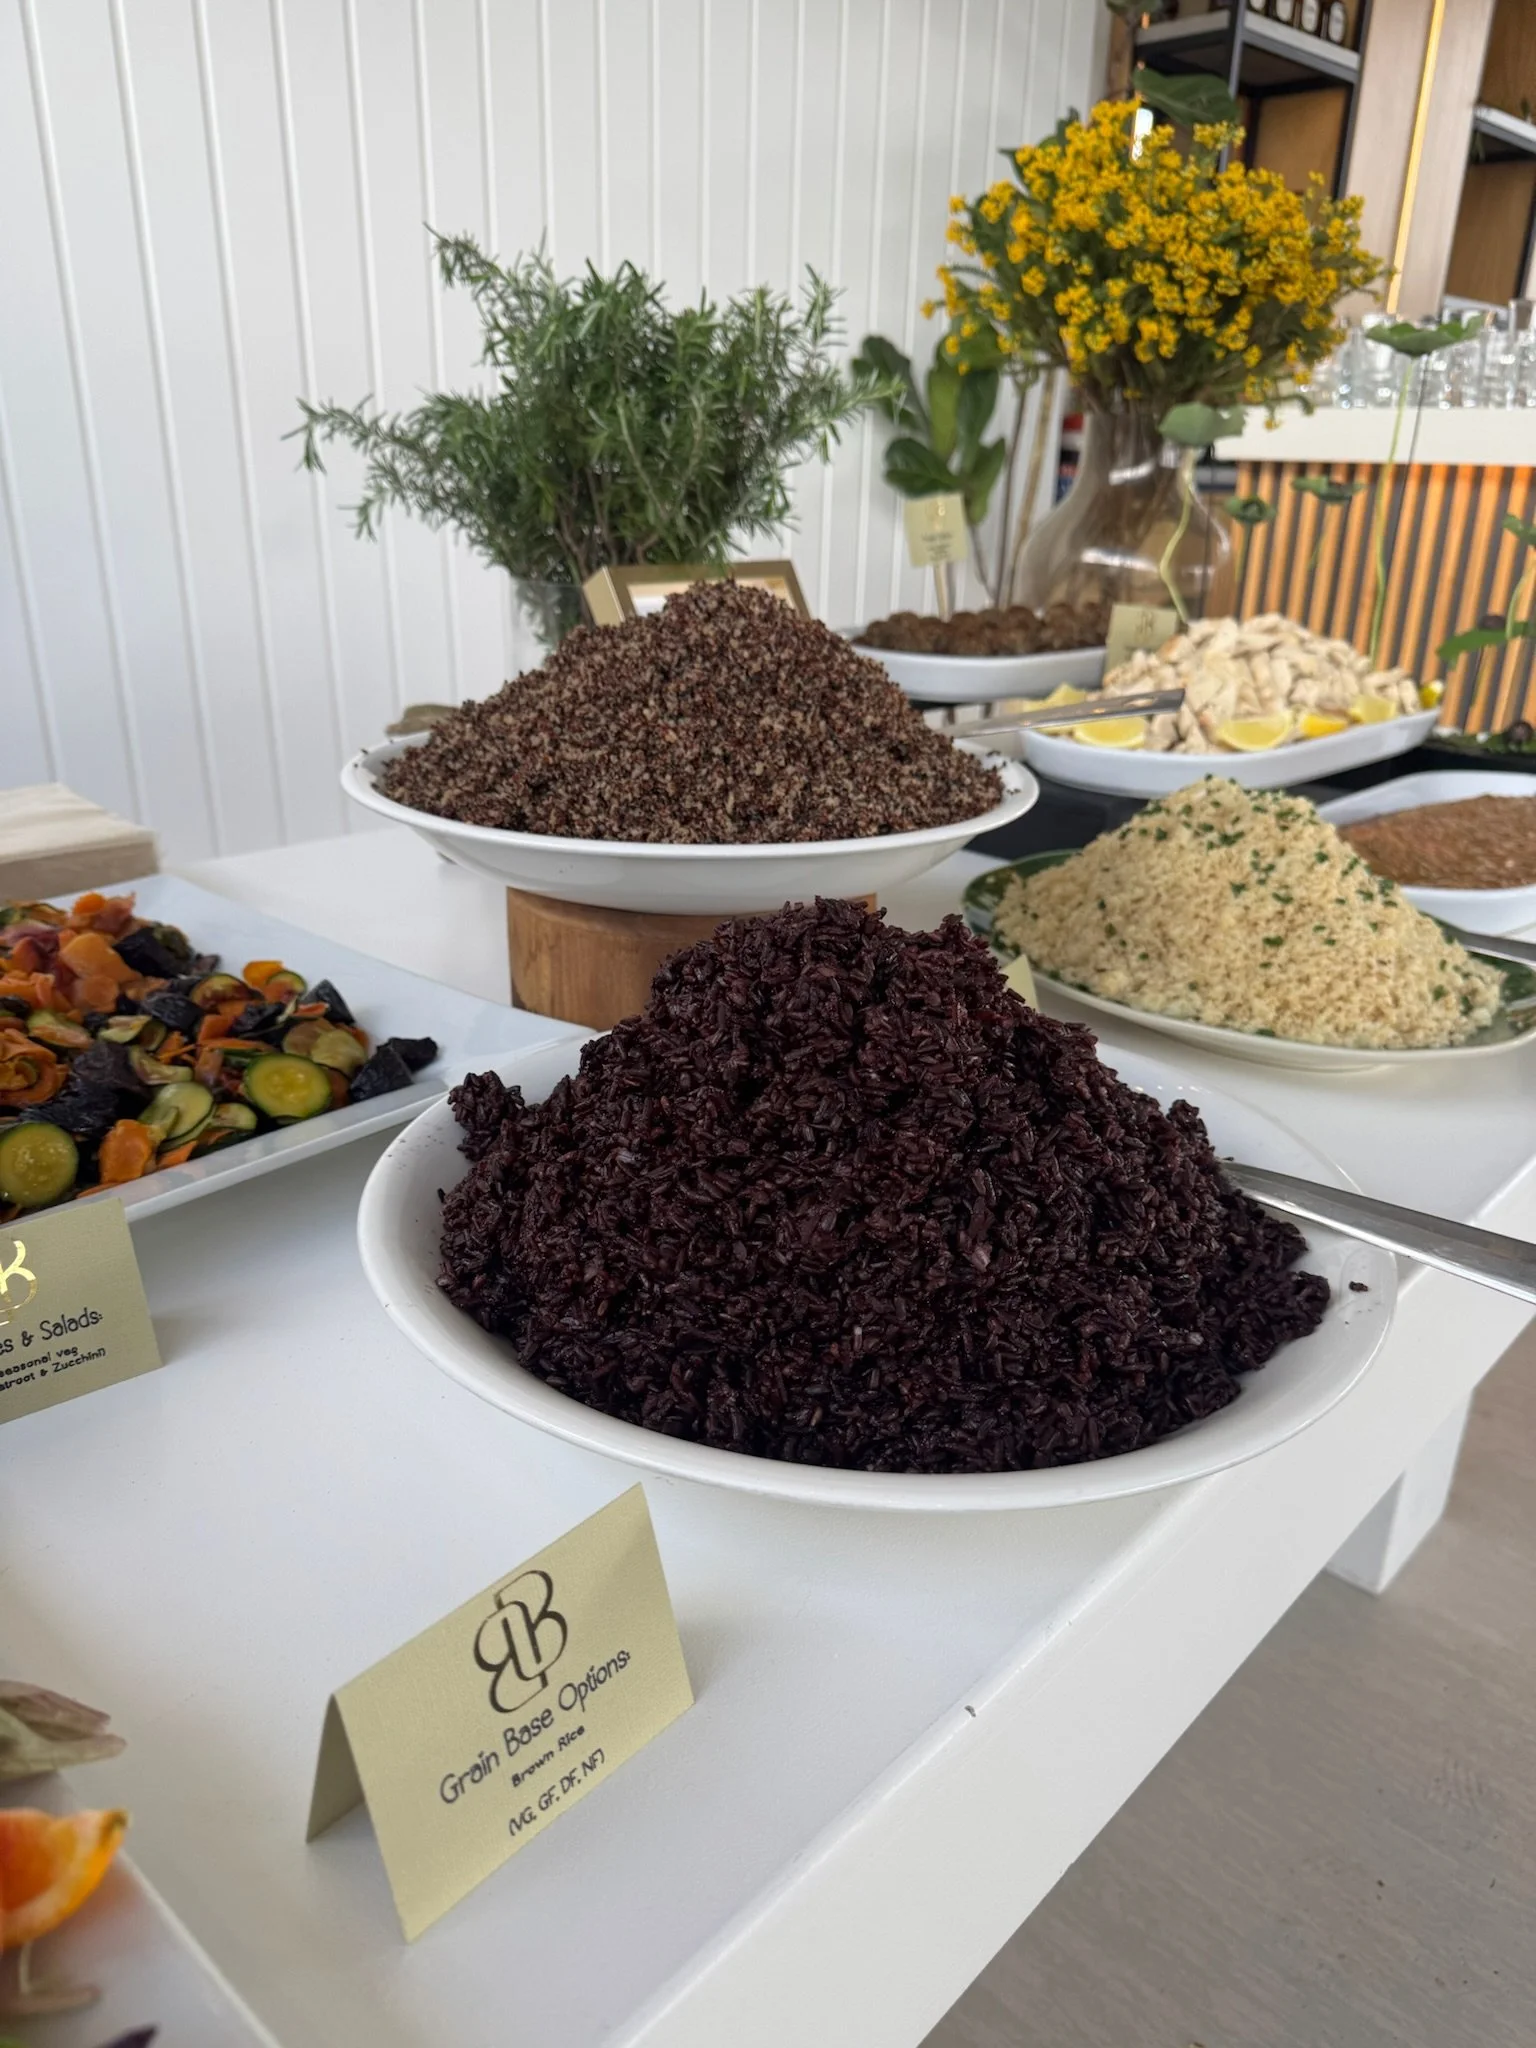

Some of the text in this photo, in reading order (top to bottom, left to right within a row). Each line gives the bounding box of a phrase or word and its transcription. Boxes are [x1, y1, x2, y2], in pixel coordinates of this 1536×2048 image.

[21, 1330, 34, 1347] &
[39, 1307, 103, 1340] Salads:
[52, 1347, 106, 1373] Zucchini)
[56, 1346, 78, 1357] veg
[439, 1650, 631, 1804] Grain Base Options:
[511, 1725, 585, 1788] Brown Rice
[581, 1747, 605, 1777] NF)
